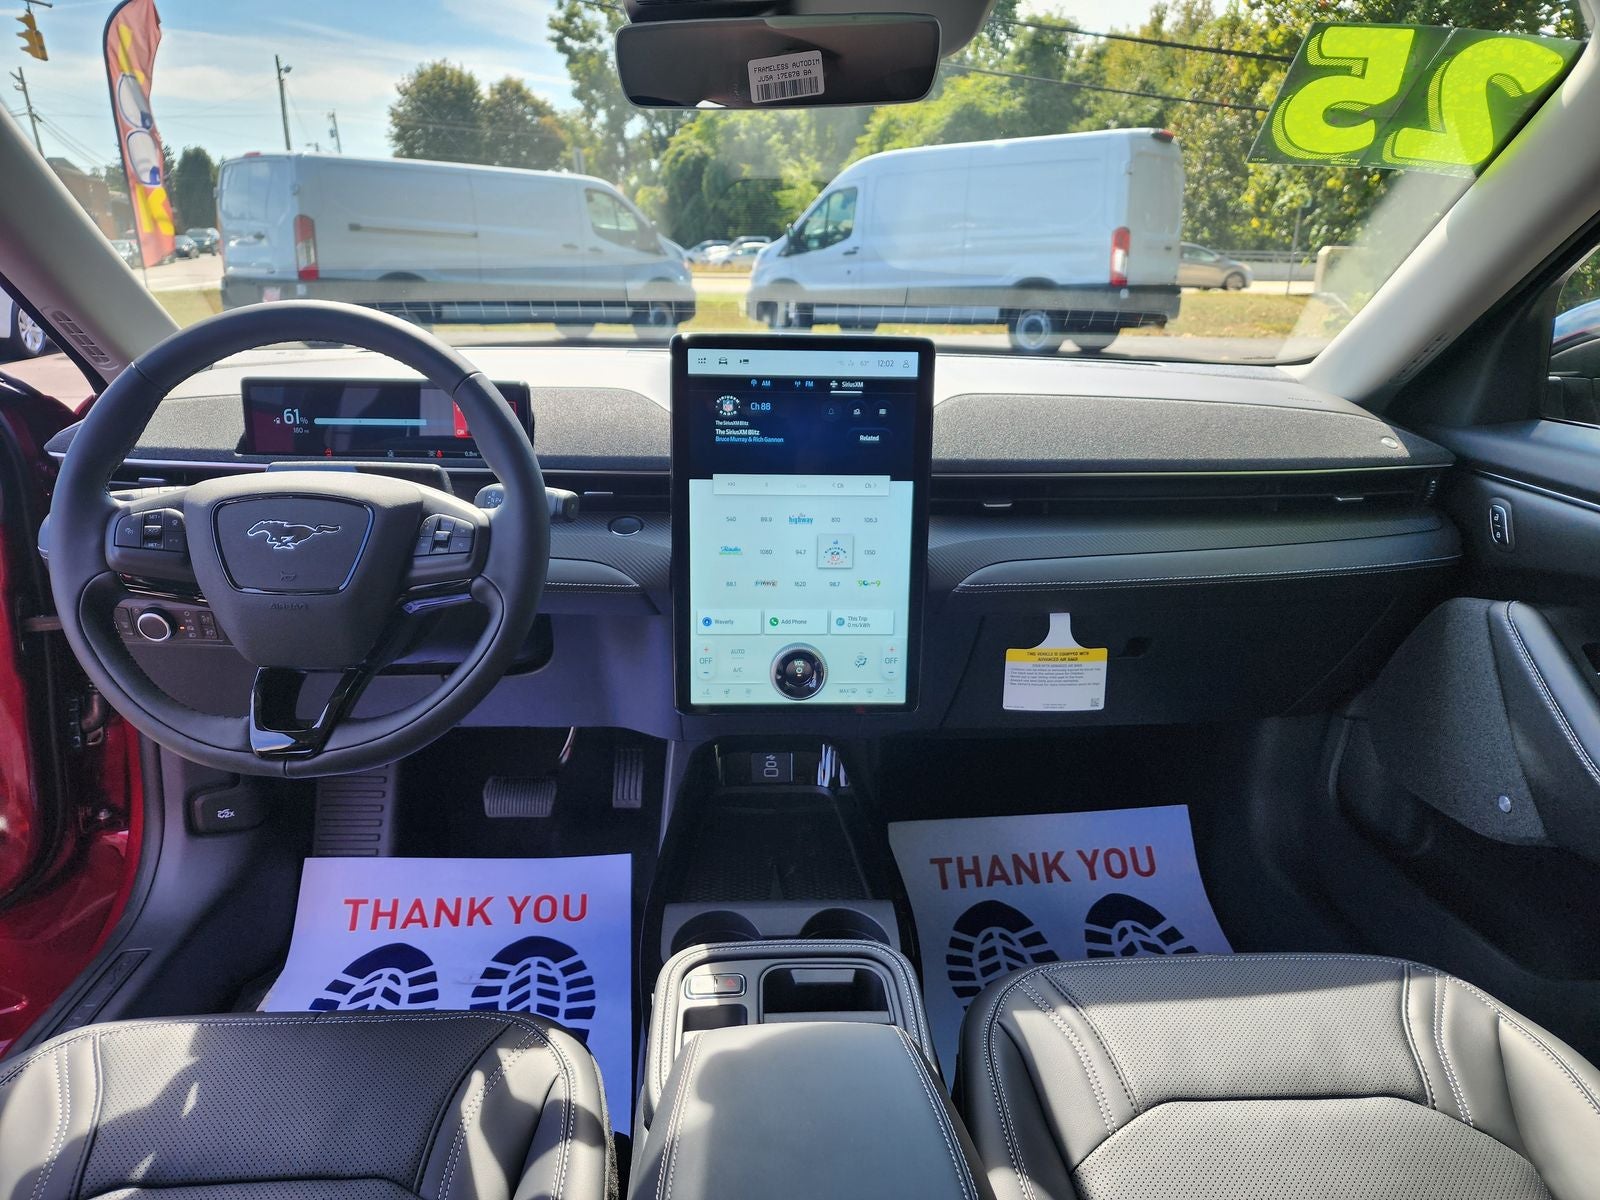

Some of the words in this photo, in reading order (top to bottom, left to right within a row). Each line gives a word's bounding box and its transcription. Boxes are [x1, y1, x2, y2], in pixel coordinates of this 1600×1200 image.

[754, 63, 789, 74] FRAMELESS
[792, 58, 820, 69] AUTODIM
[877, 359, 895, 368] 12:02
[805, 380, 814, 388] FM
[841, 380, 864, 389] SiriusXM
[750, 402, 760, 411] Ch
[860, 434, 879, 442] Related
[858, 615, 868, 623] Trip
[699, 657, 713, 665] OFF
[884, 657, 898, 665] OFF
[929, 850, 1072, 890] THANK
[1075, 845, 1158, 880] YOU
[343, 896, 495, 932] THANK
[507, 894, 589, 925] YOU
